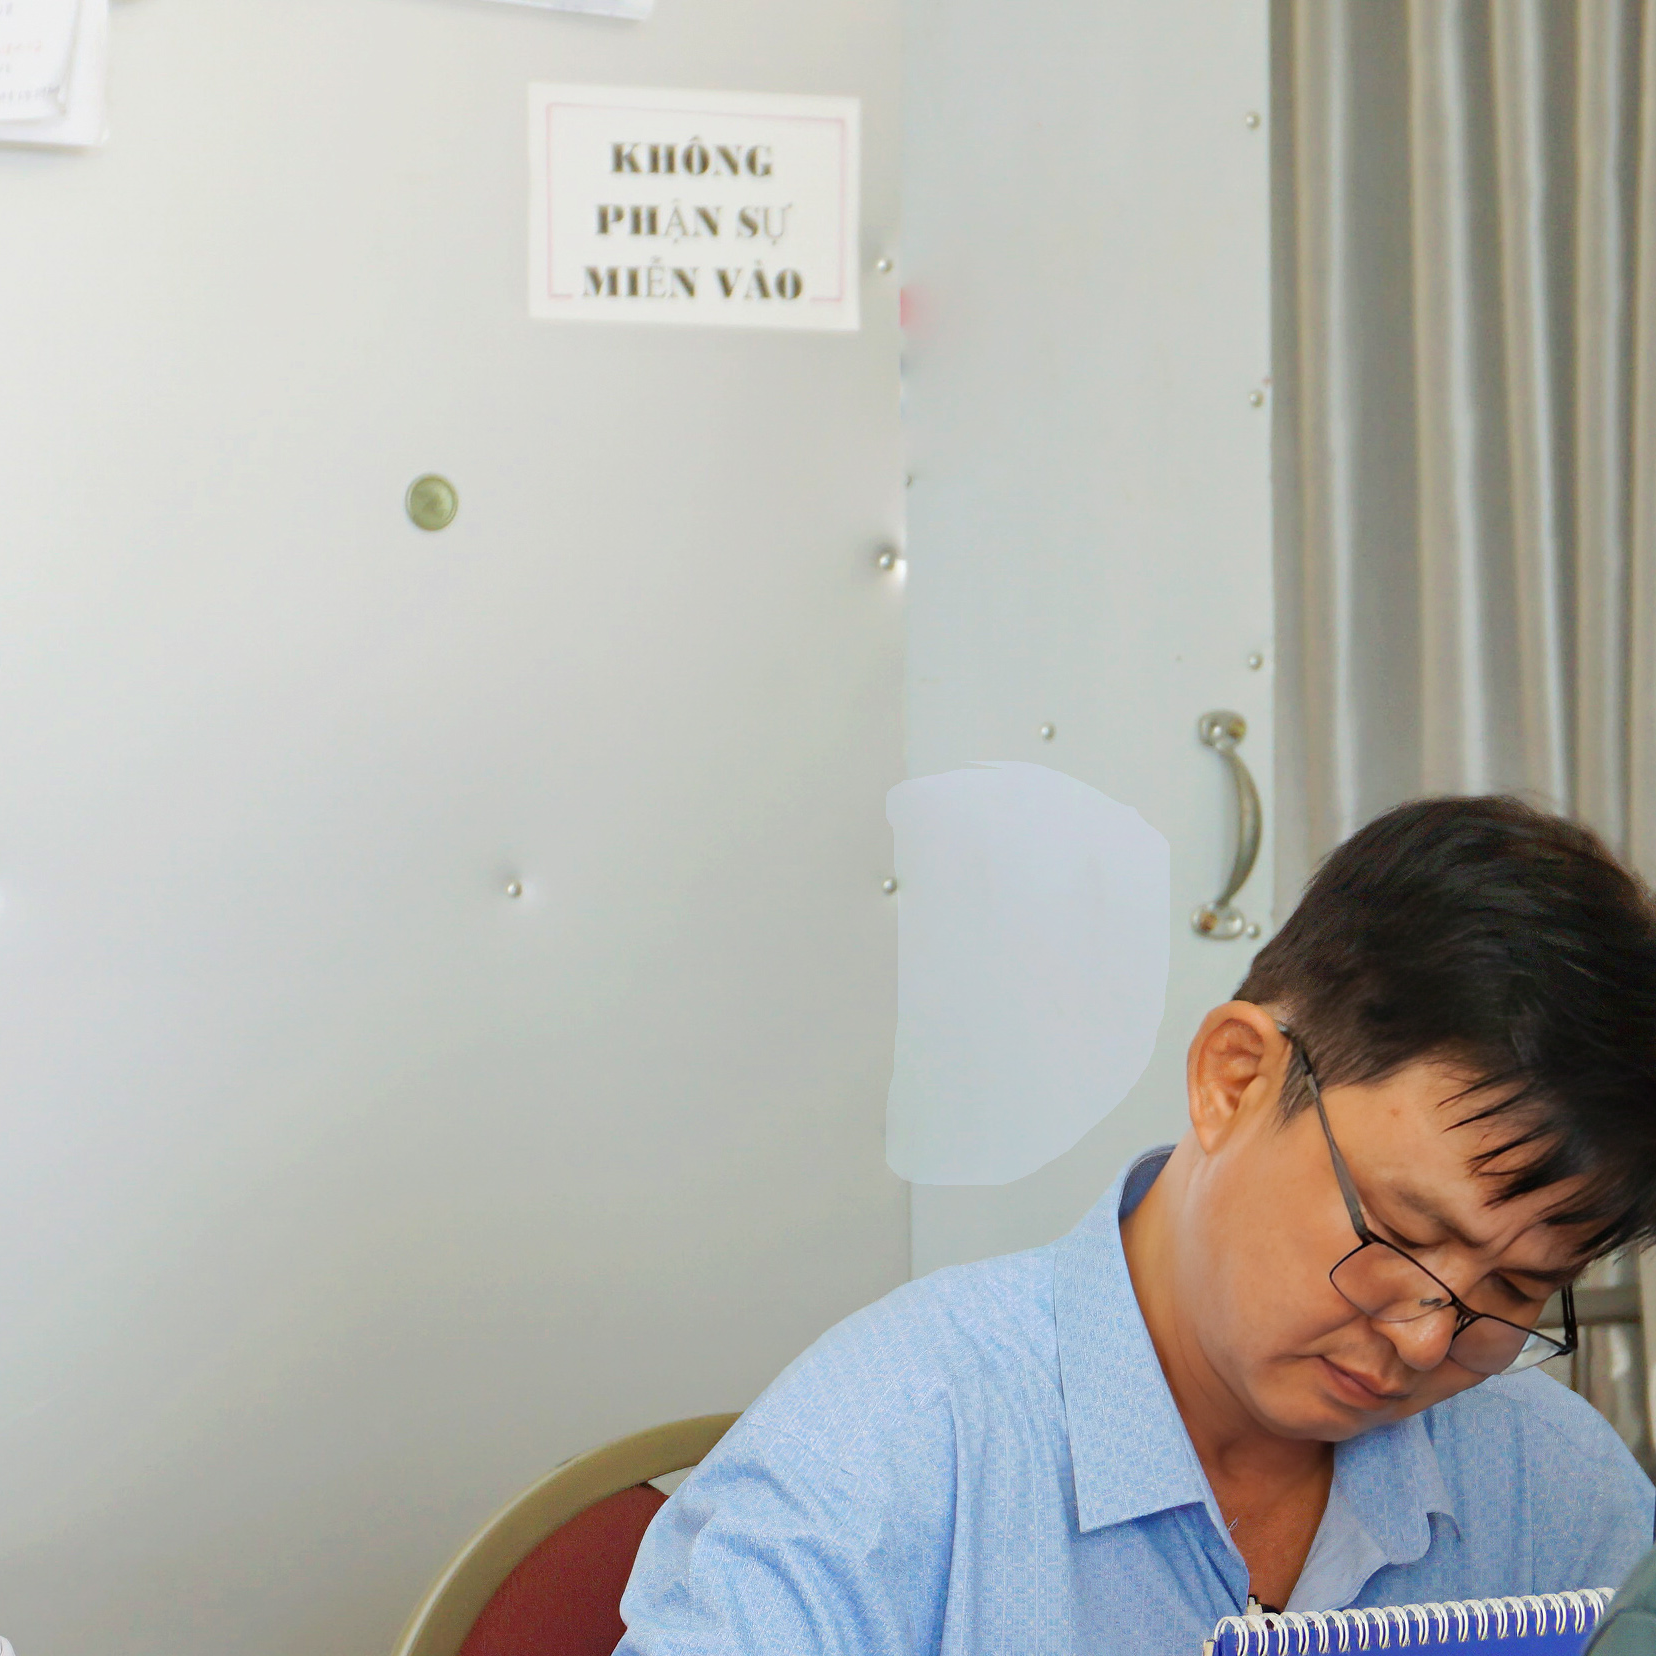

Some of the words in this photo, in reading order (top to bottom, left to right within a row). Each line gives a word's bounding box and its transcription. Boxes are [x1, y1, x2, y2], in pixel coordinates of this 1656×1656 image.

[609, 134, 774, 177] KHÔNG
[596, 199, 722, 244] PHẬN
[736, 203, 793, 246] SỰ
[582, 256, 701, 299] MIỄN
[713, 259, 804, 300] VÀO
